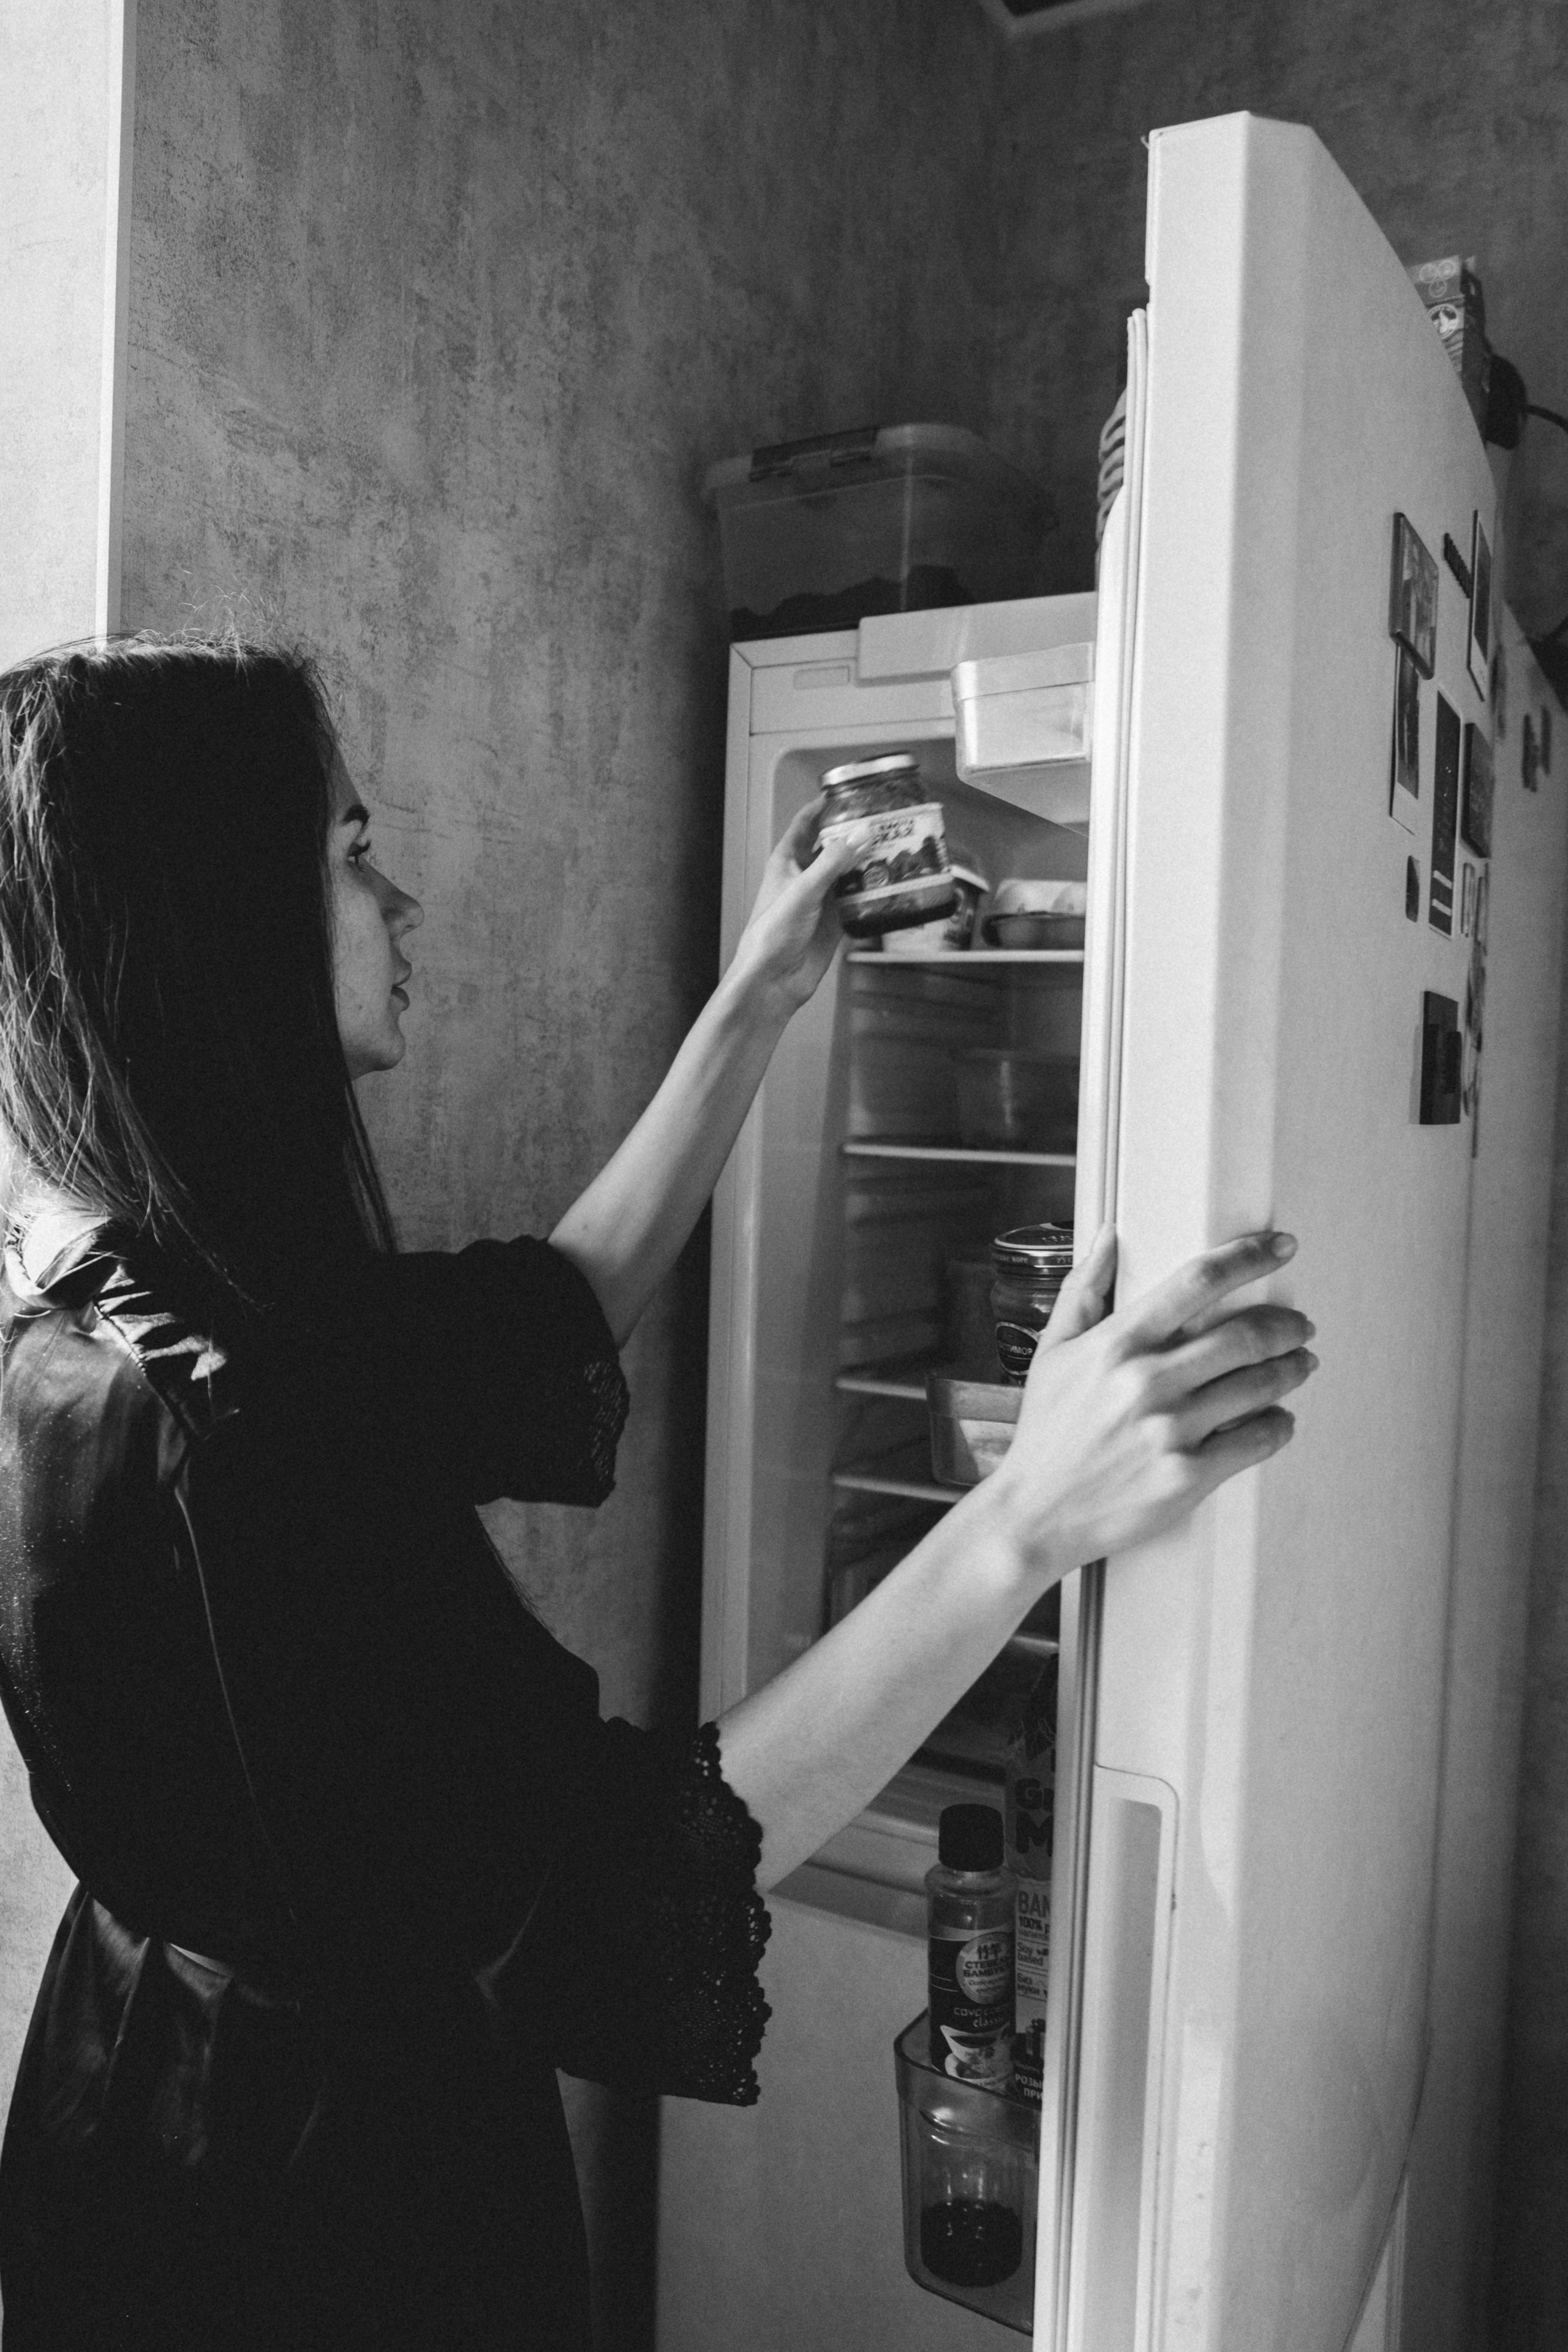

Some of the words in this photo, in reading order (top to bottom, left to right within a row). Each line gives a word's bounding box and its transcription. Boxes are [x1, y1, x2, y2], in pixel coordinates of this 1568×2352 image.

[1019, 1916, 1042, 1931] 100%
[1017, 1942, 1033, 1956] Soy
[1017, 1953, 1043, 1966] based
